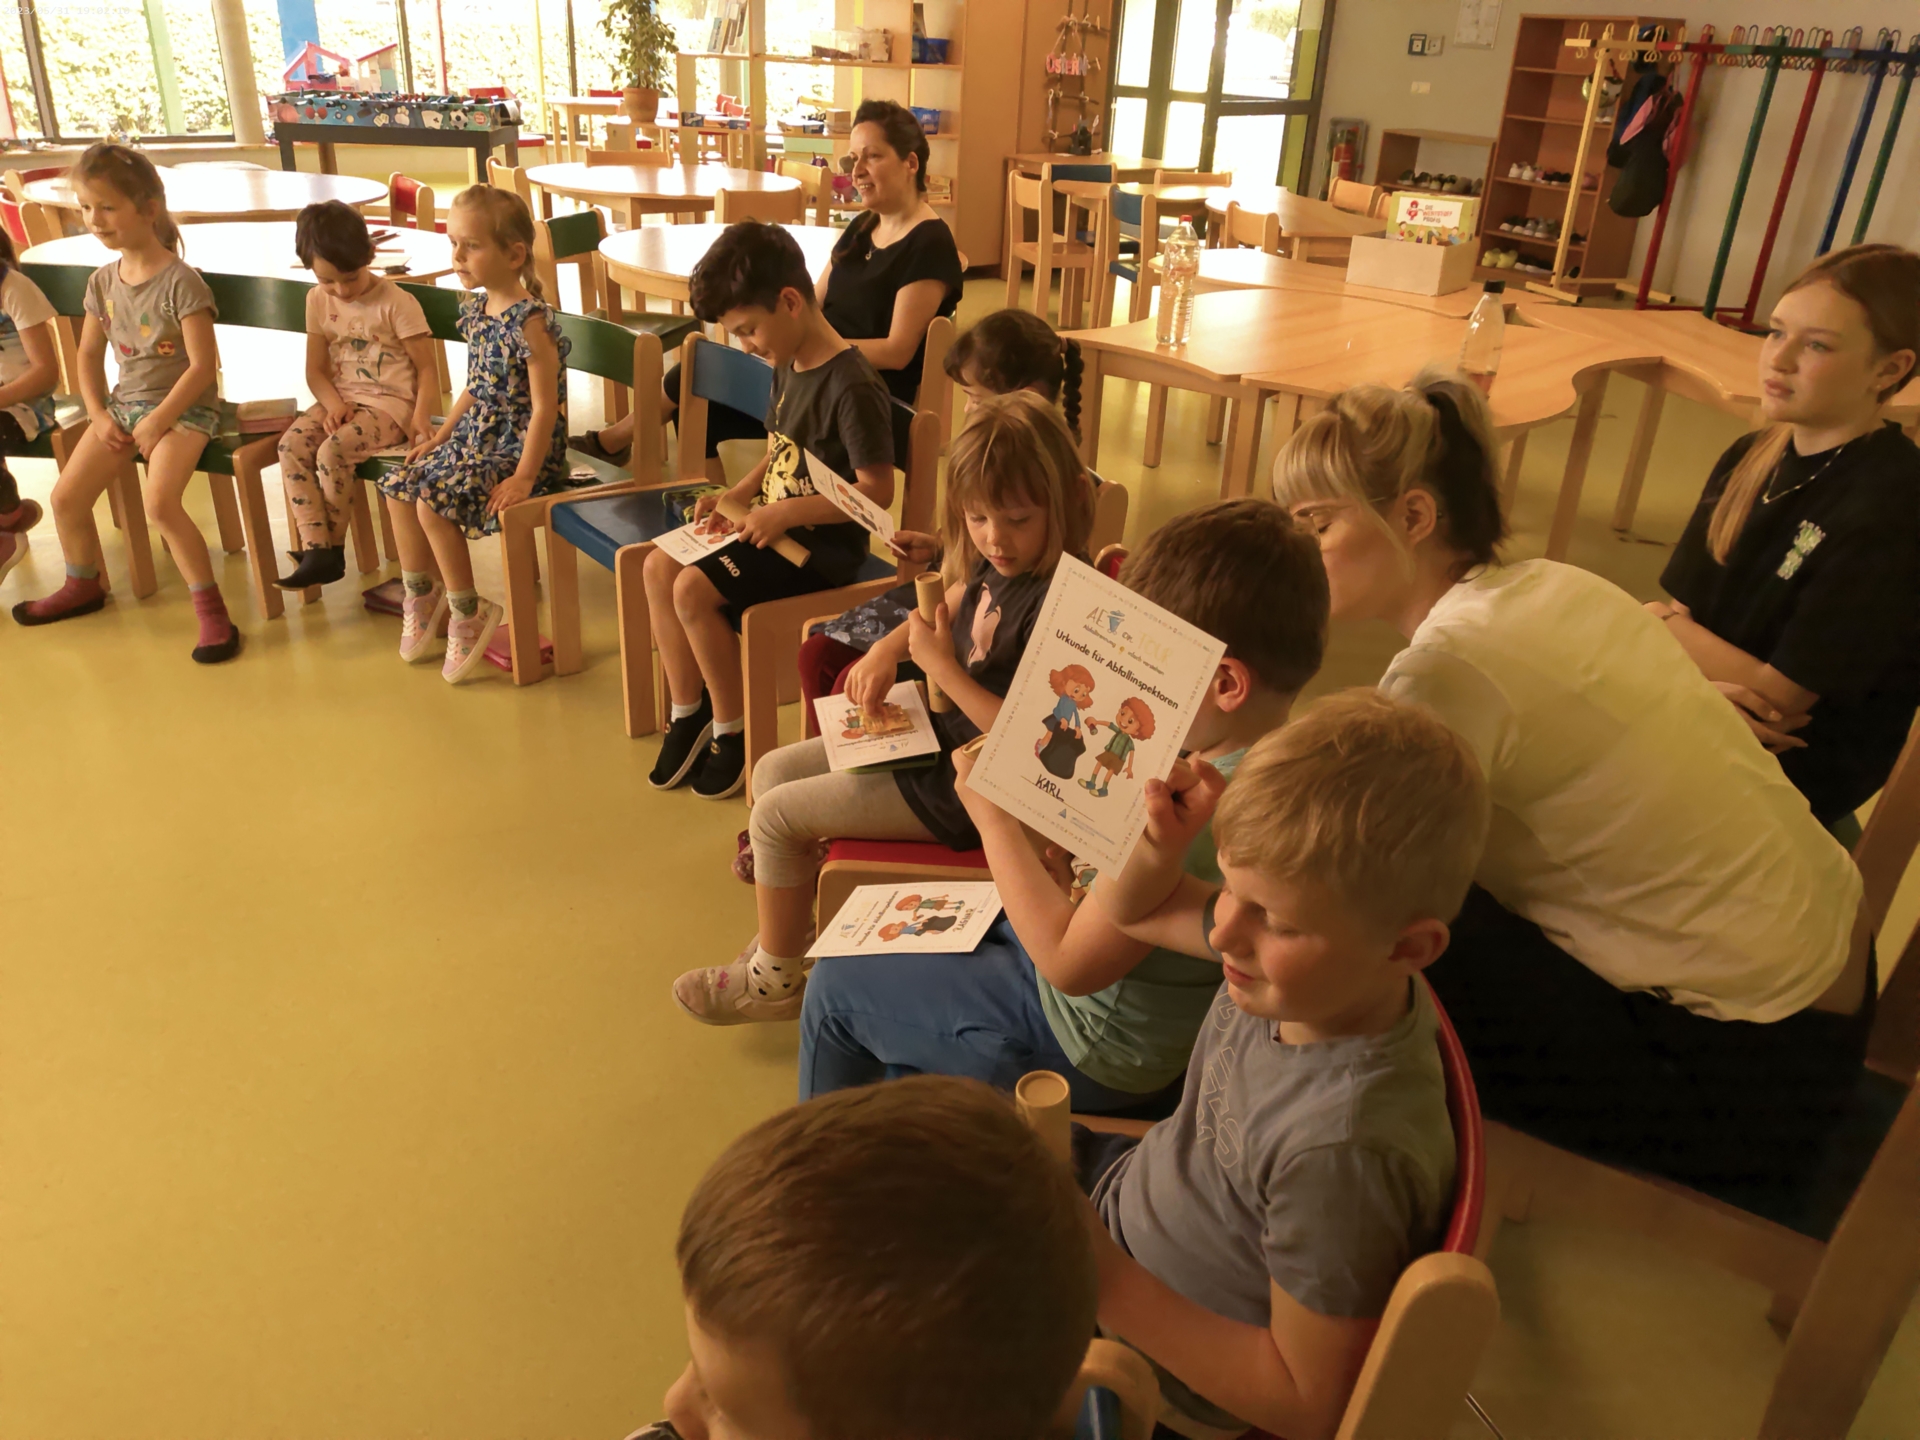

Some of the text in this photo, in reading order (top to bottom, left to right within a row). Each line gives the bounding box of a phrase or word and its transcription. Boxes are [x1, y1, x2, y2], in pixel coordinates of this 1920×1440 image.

[1046, 53, 1088, 76] OSTERN
[719, 555, 740, 577] JAKO
[1056, 628, 1179, 710] Urkunde für Abfallinspektoren
[1035, 773, 1065, 803] KARL
